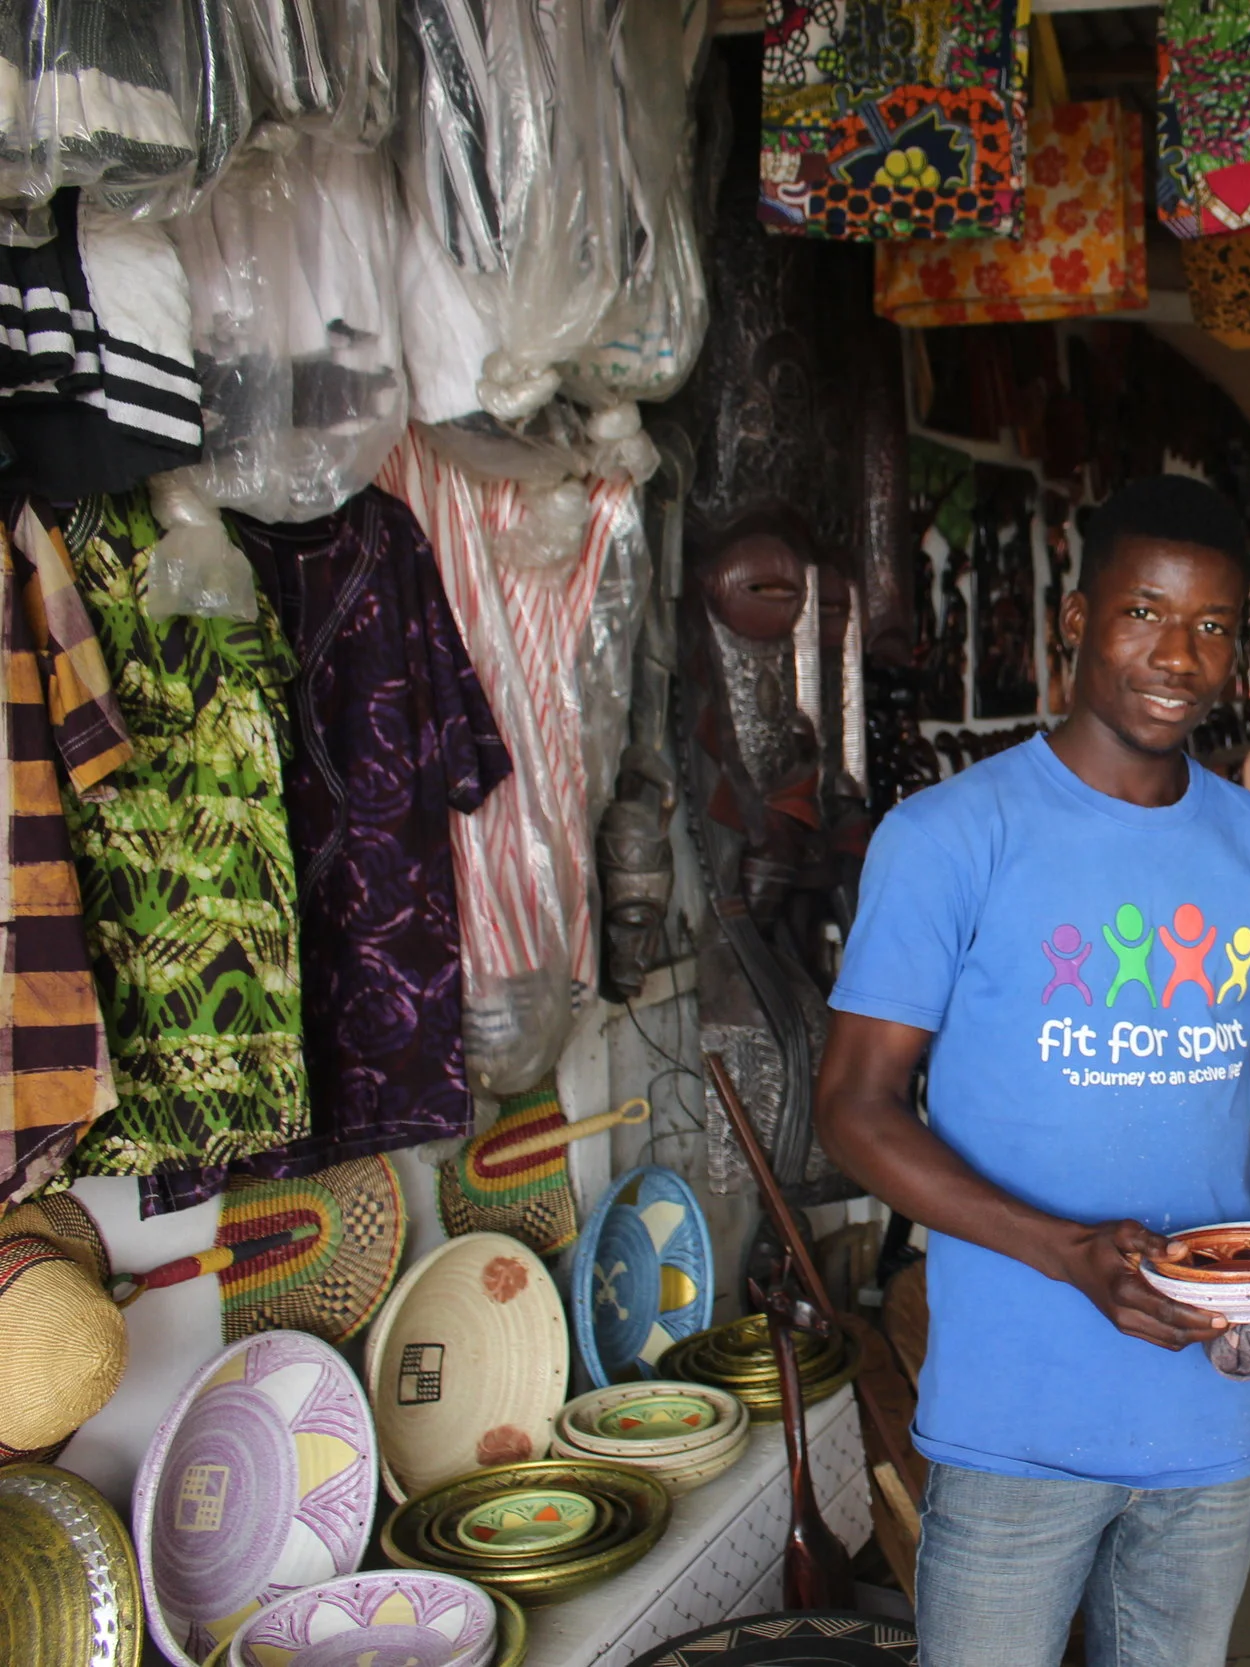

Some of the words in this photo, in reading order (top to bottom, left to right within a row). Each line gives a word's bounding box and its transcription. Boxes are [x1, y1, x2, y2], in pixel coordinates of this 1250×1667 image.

[1037, 1017, 1097, 1062] fit
[1107, 1021, 1169, 1064] for
[1178, 1019, 1247, 1062] sport
[1082, 1068, 1146, 1087] journey
[1148, 1071, 1166, 1084] to
[1169, 1071, 1186, 1085] an
[1188, 1066, 1226, 1084] active
